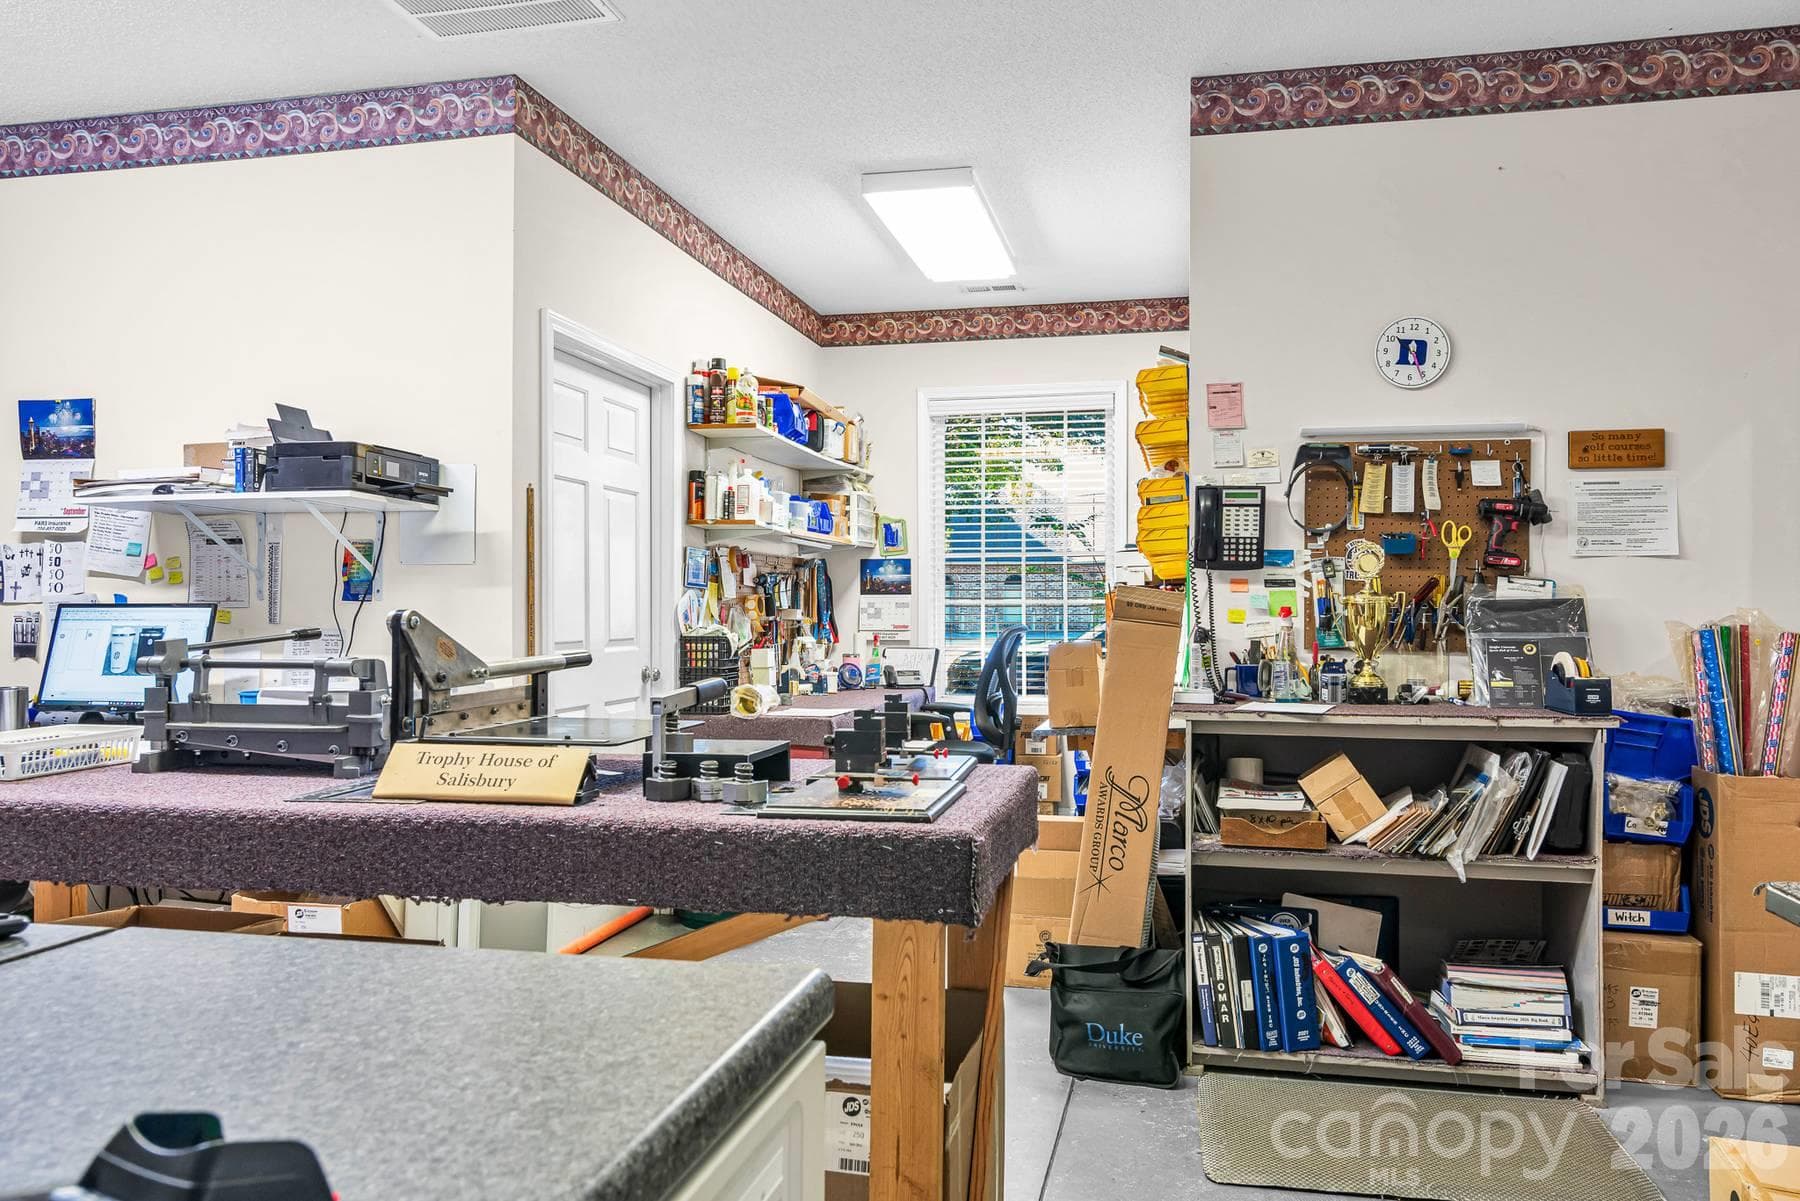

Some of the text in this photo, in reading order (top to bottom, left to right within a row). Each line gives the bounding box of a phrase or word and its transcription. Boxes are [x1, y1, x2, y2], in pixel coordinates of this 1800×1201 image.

[1396, 326, 1405, 334] 11
[1409, 323, 1420, 331] 12
[1433, 336, 1439, 344] 2
[1383, 347, 1389, 355] 9
[1435, 349, 1442, 357] 3
[1394, 369, 1400, 377] 7
[1407, 373, 1413, 381] 6
[1591, 432, 1642, 442] So many
[1608, 442, 1652, 451] courses
[1593, 453, 1623, 463] little
[1626, 452, 1657, 462] time!
[63, 507, 87, 515] September
[416, 751, 560, 770] Trophy House of
[436, 772, 517, 792] Salisbury
[1105, 765, 1150, 872] Marco
[1699, 793, 1713, 835] JDS
[1090, 782, 1108, 874] AWARDS GROUP
[1615, 911, 1646, 923] Witch
[1085, 1022, 1143, 1046] Duke
[844, 1099, 860, 1113] JDS
